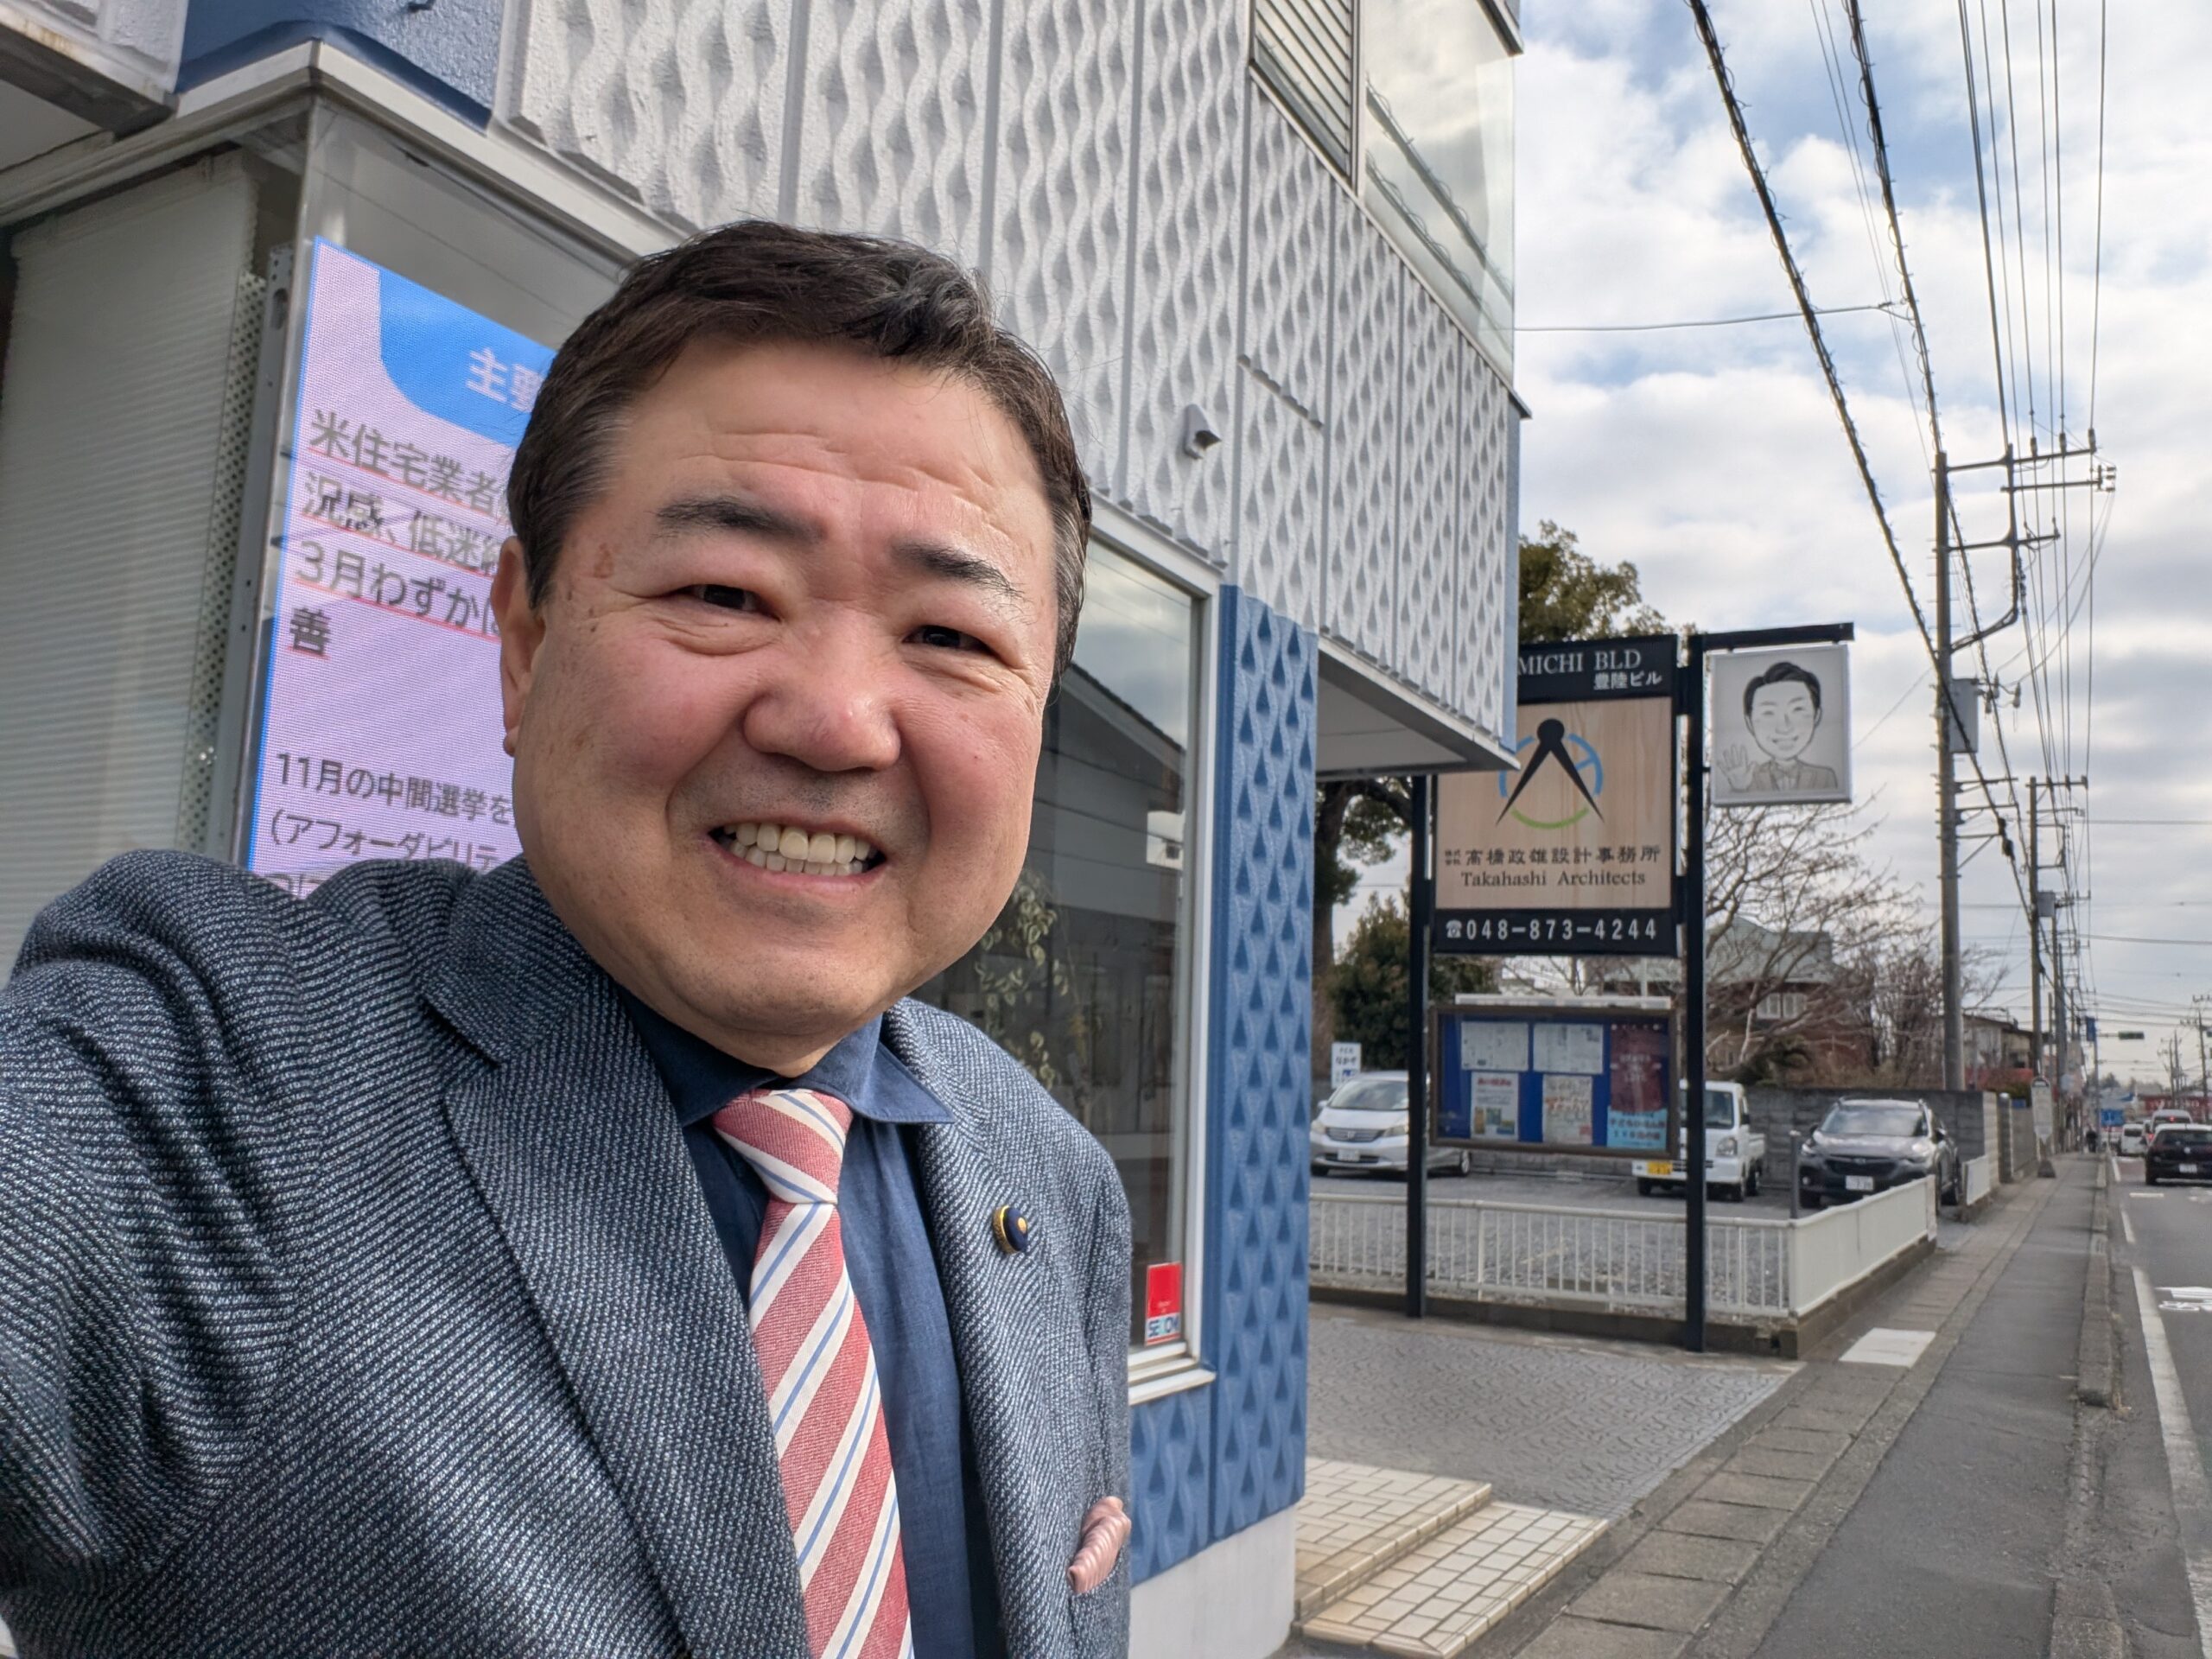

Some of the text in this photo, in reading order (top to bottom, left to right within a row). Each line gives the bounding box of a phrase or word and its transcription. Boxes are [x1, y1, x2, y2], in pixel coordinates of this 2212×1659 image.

[308, 408, 507, 517] 米住宅業者
[289, 607, 332, 656] 善
[1593, 648, 1642, 671] BLD
[1461, 868, 1646, 887] Takahashi Architects
[1466, 918, 1656, 941] 048-873-4244
